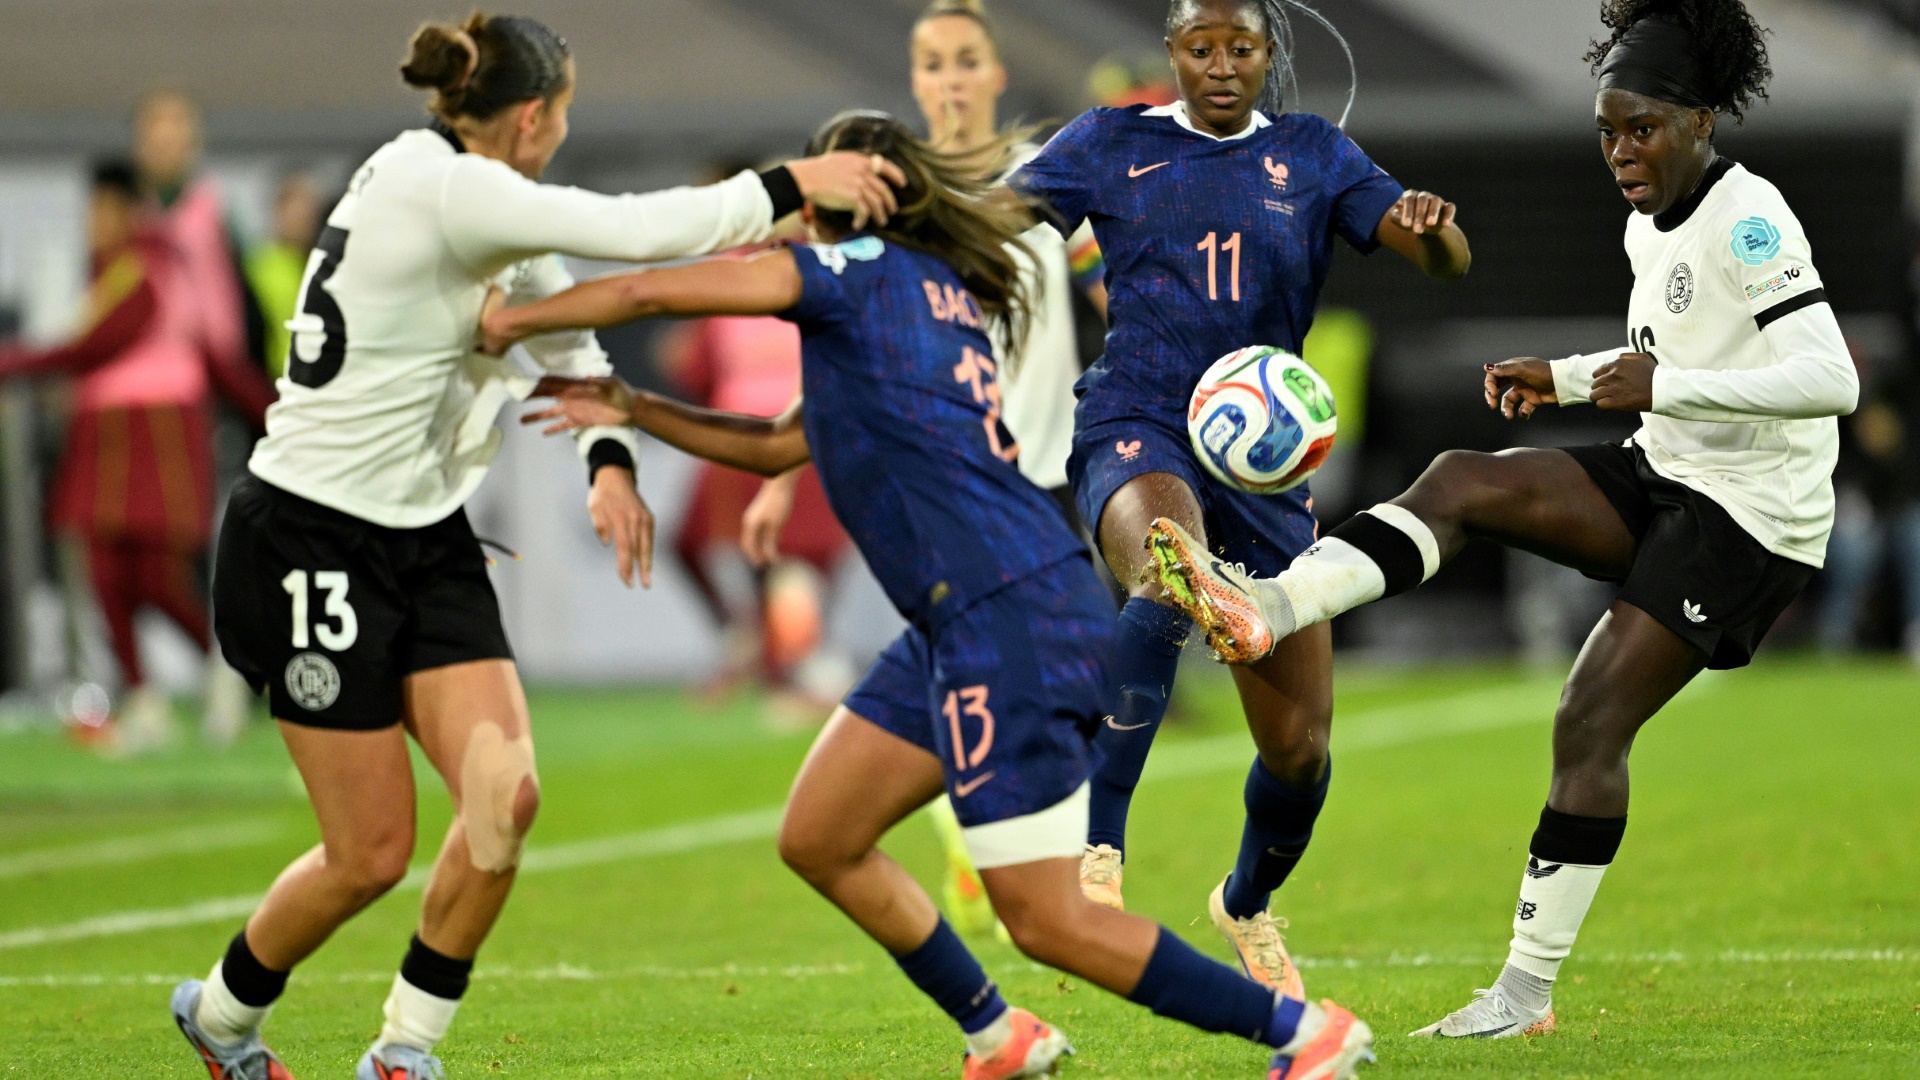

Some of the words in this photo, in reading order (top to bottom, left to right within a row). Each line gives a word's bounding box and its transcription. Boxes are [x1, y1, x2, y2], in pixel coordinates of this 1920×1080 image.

[1197, 232, 1241, 301] 11
[281, 568, 358, 652] 13
[942, 684, 995, 771] 13
